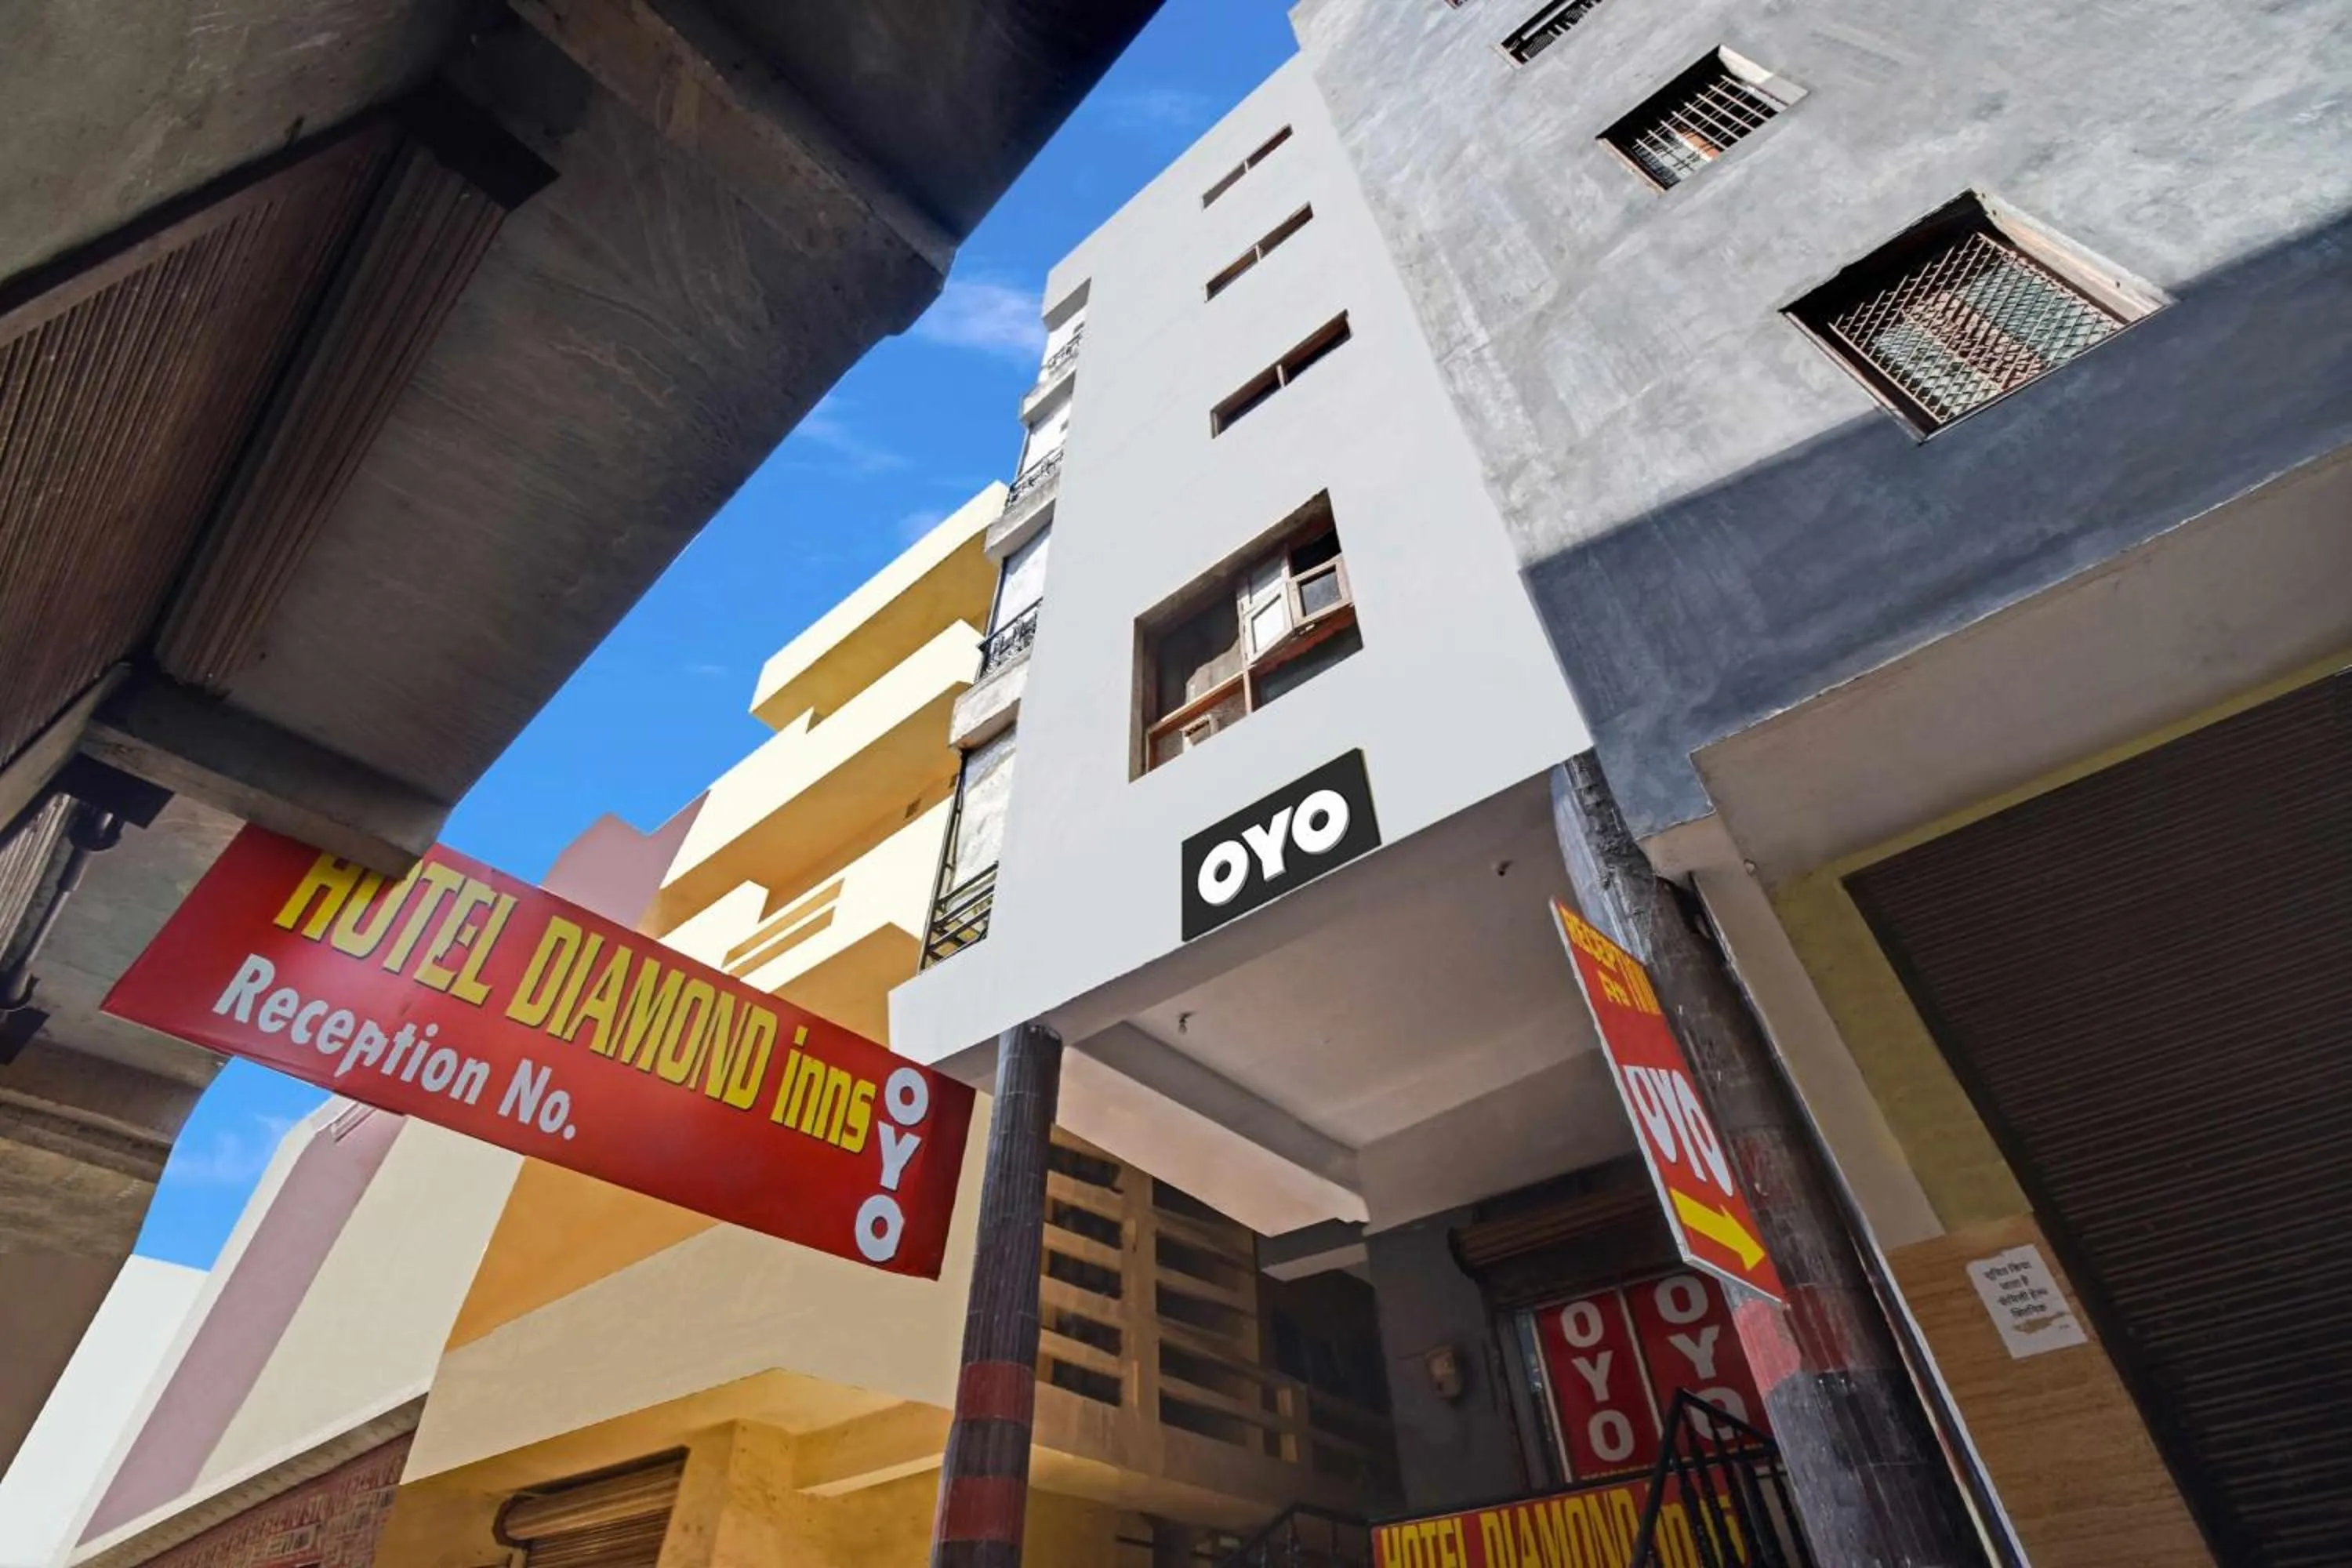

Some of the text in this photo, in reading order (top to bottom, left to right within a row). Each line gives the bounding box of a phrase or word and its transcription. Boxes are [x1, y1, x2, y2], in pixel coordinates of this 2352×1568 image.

[1197, 789, 1349, 906] OYO
[212, 953, 576, 1140] Reception No.
[273, 853, 877, 1153] HOTEL DIAMOND inns
[855, 1066, 929, 1262] OYO
[1622, 1065, 1733, 1197] OYO
[1560, 1301, 1635, 1461] OYO
[1479, 1488, 1640, 1568] DIAMOND
